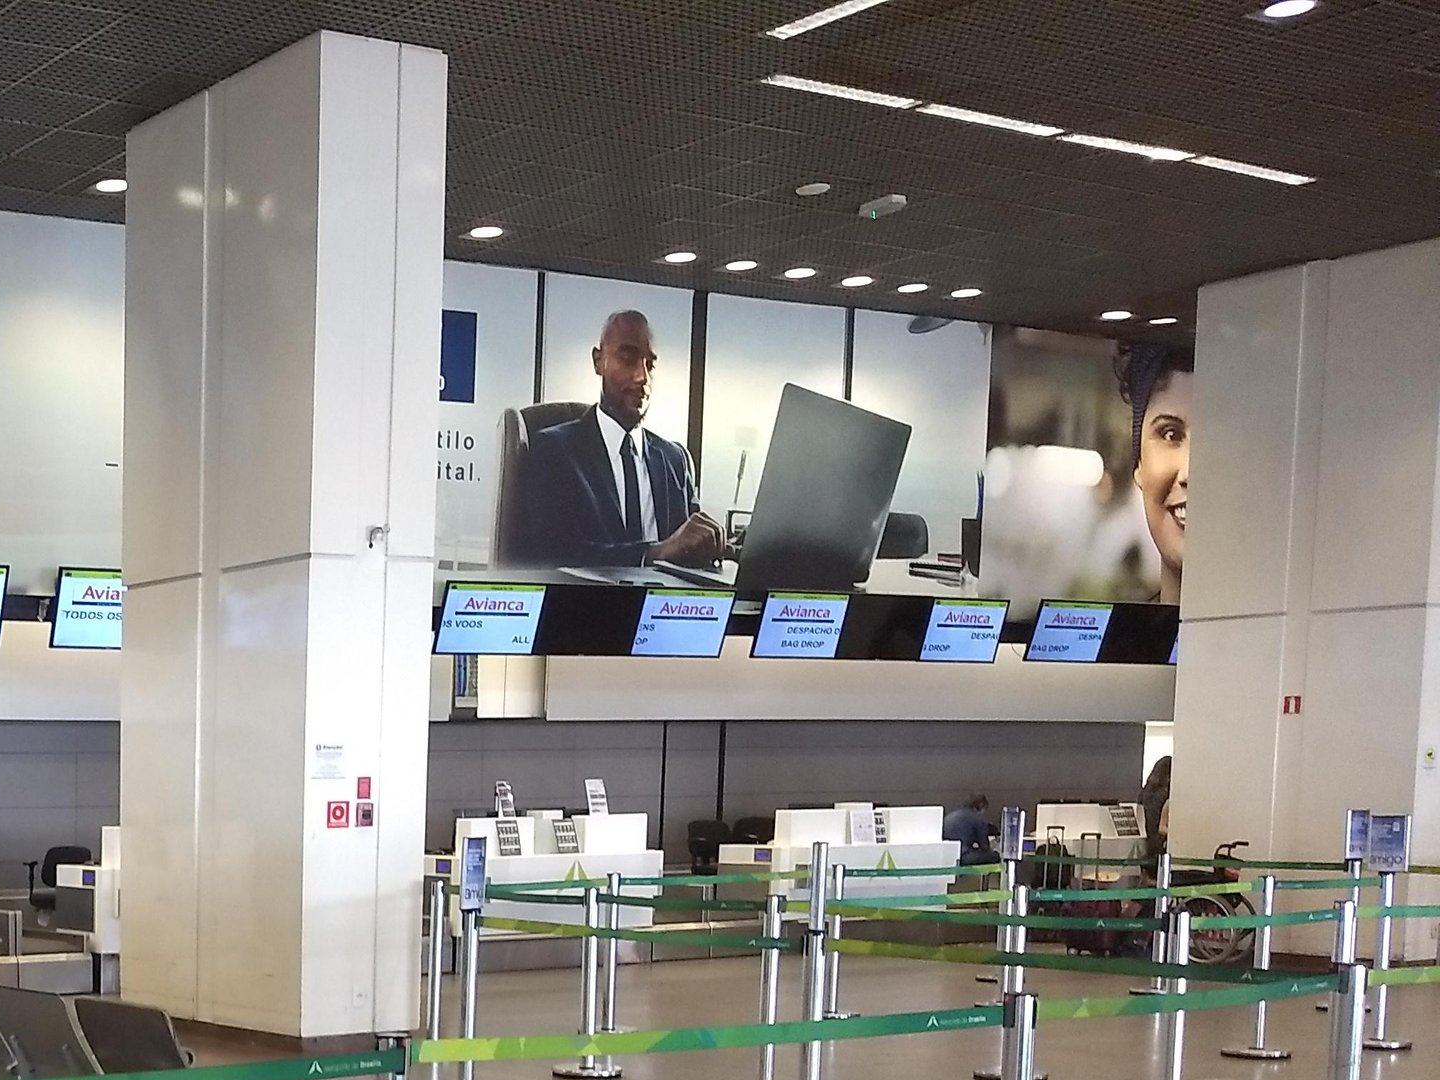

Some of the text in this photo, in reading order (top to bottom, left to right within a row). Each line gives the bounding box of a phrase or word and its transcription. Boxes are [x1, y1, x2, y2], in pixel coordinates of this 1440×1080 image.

[464, 597, 524, 611] Avianca
[660, 602, 715, 616] Avianca
[63, 610, 104, 620] TODOS
[780, 605, 831, 618] Avianca
[945, 611, 991, 624] Avianca
[1052, 613, 1097, 626] Avianca
[455, 620, 483, 629] VOOS
[787, 627, 832, 635] DESPACHO
[512, 636, 530, 644] ALL
[781, 640, 825, 648] BAG DROP
[928, 644, 951, 652] DROP
